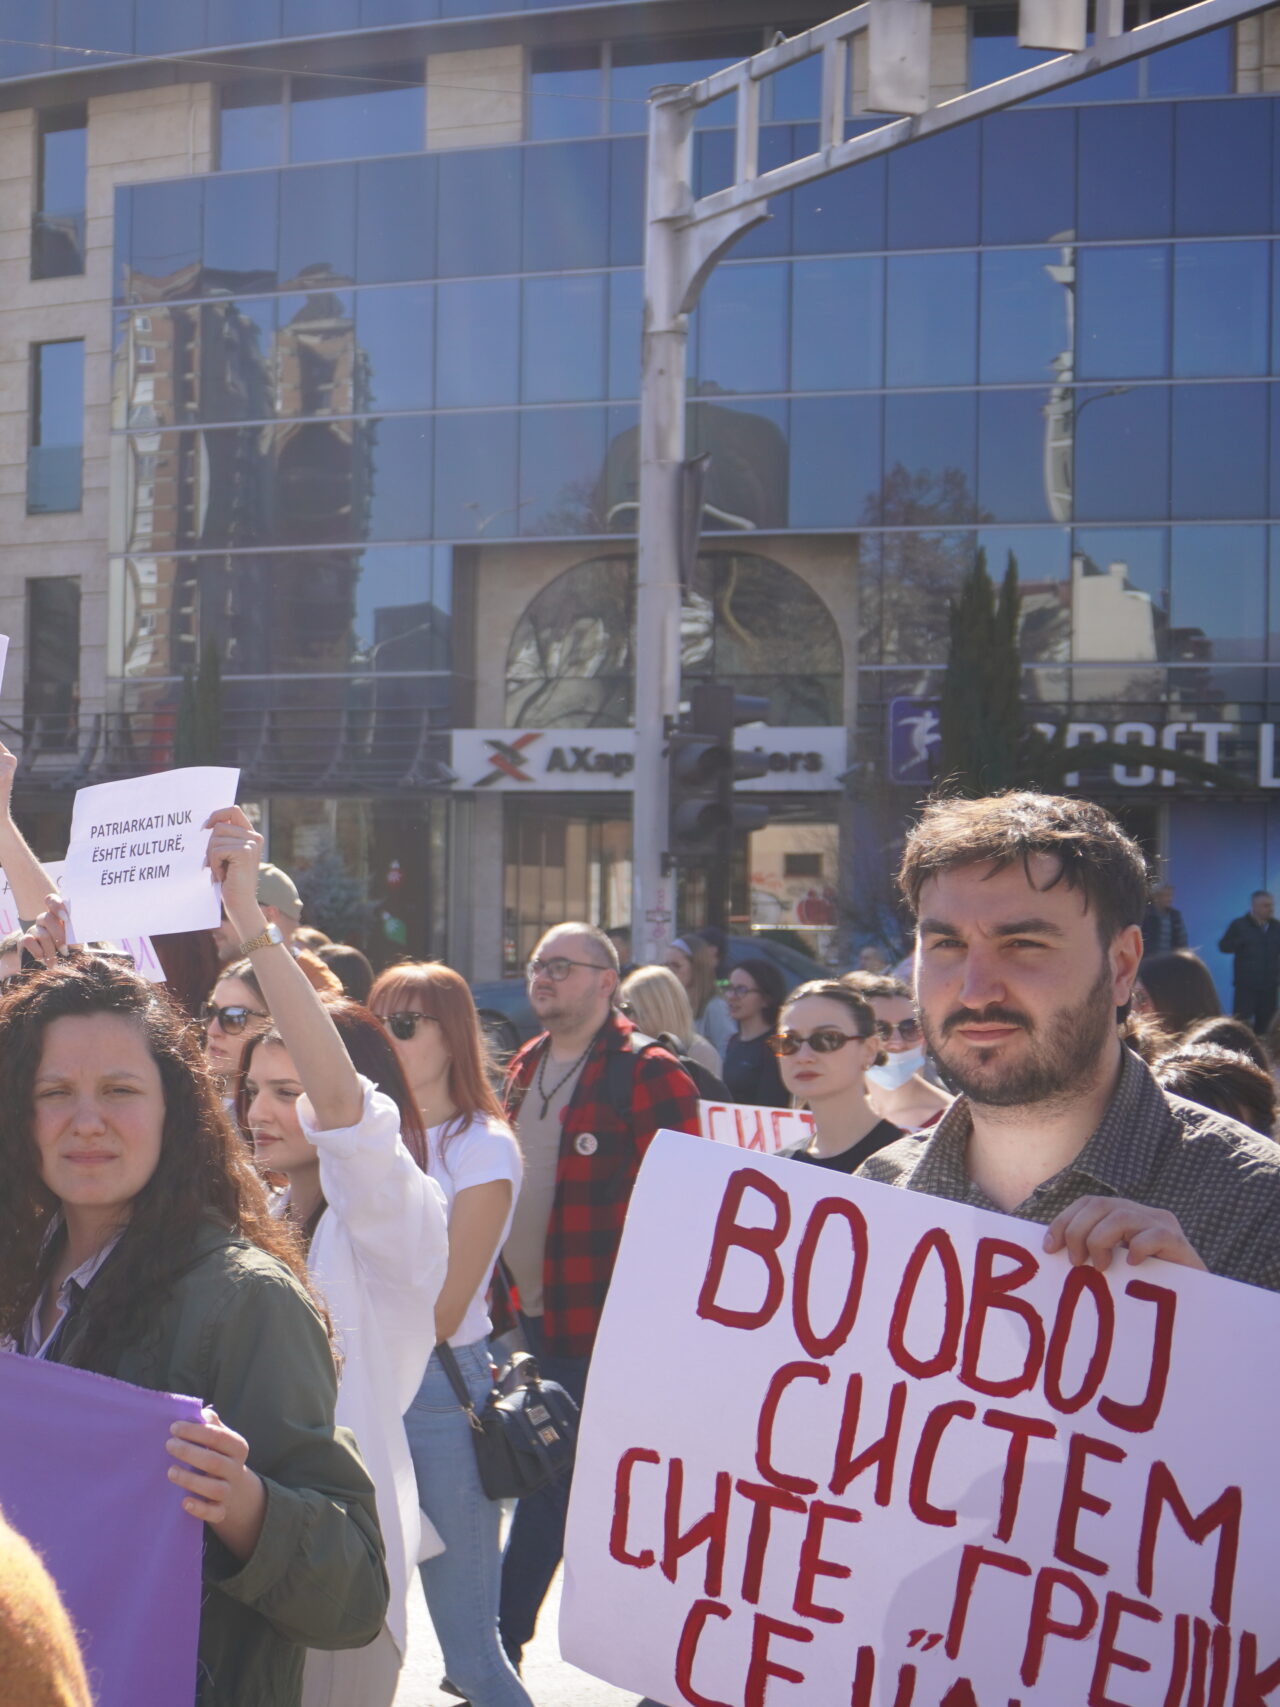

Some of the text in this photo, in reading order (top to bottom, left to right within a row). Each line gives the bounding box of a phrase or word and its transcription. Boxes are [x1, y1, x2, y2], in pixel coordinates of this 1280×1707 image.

[90, 810, 192, 839] PATRIARKATI NUK
[92, 834, 185, 863] ËSHTË KULTURË,
[100, 864, 171, 886] ËSHTË KRIM
[696, 1166, 1177, 1434] ВО ОВОЈ
[609, 1446, 862, 1624] СИТЕ
[755, 1361, 1243, 1627] СИСТЕМ
